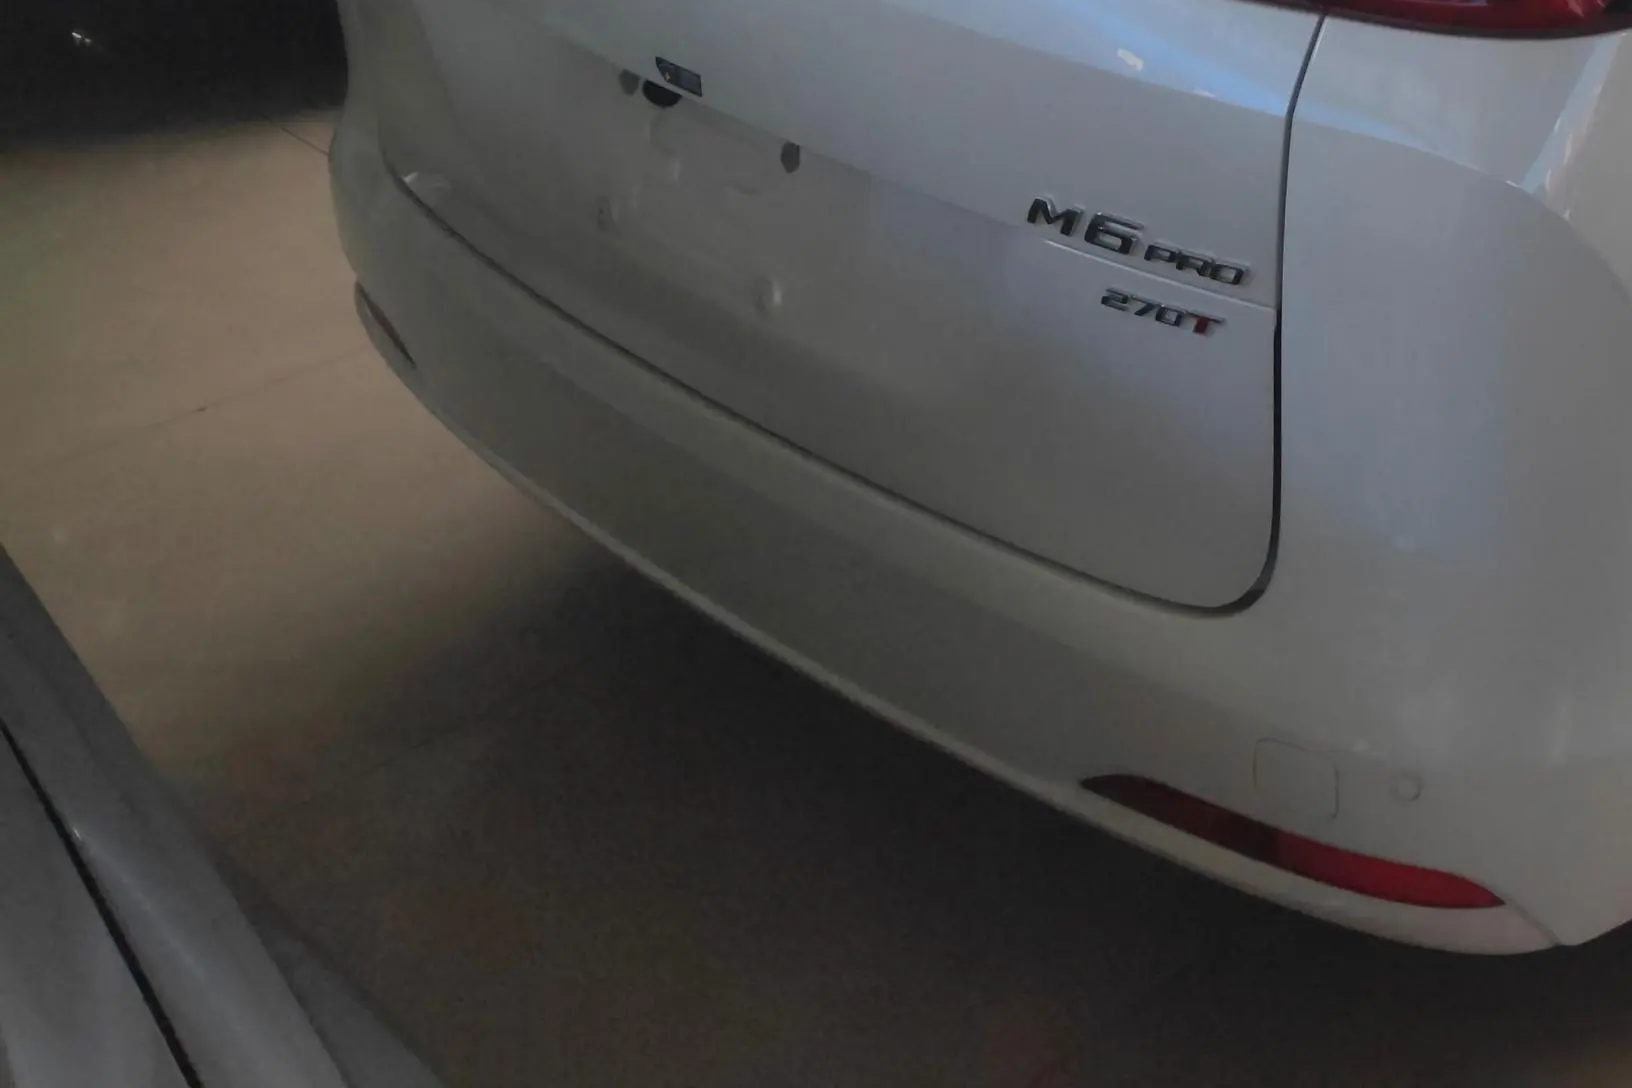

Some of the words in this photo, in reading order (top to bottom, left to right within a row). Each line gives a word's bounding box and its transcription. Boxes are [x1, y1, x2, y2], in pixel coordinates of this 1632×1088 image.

[1026, 195, 1145, 255] M6
[1144, 240, 1249, 286] PRO
[1101, 287, 1226, 336] 270T
